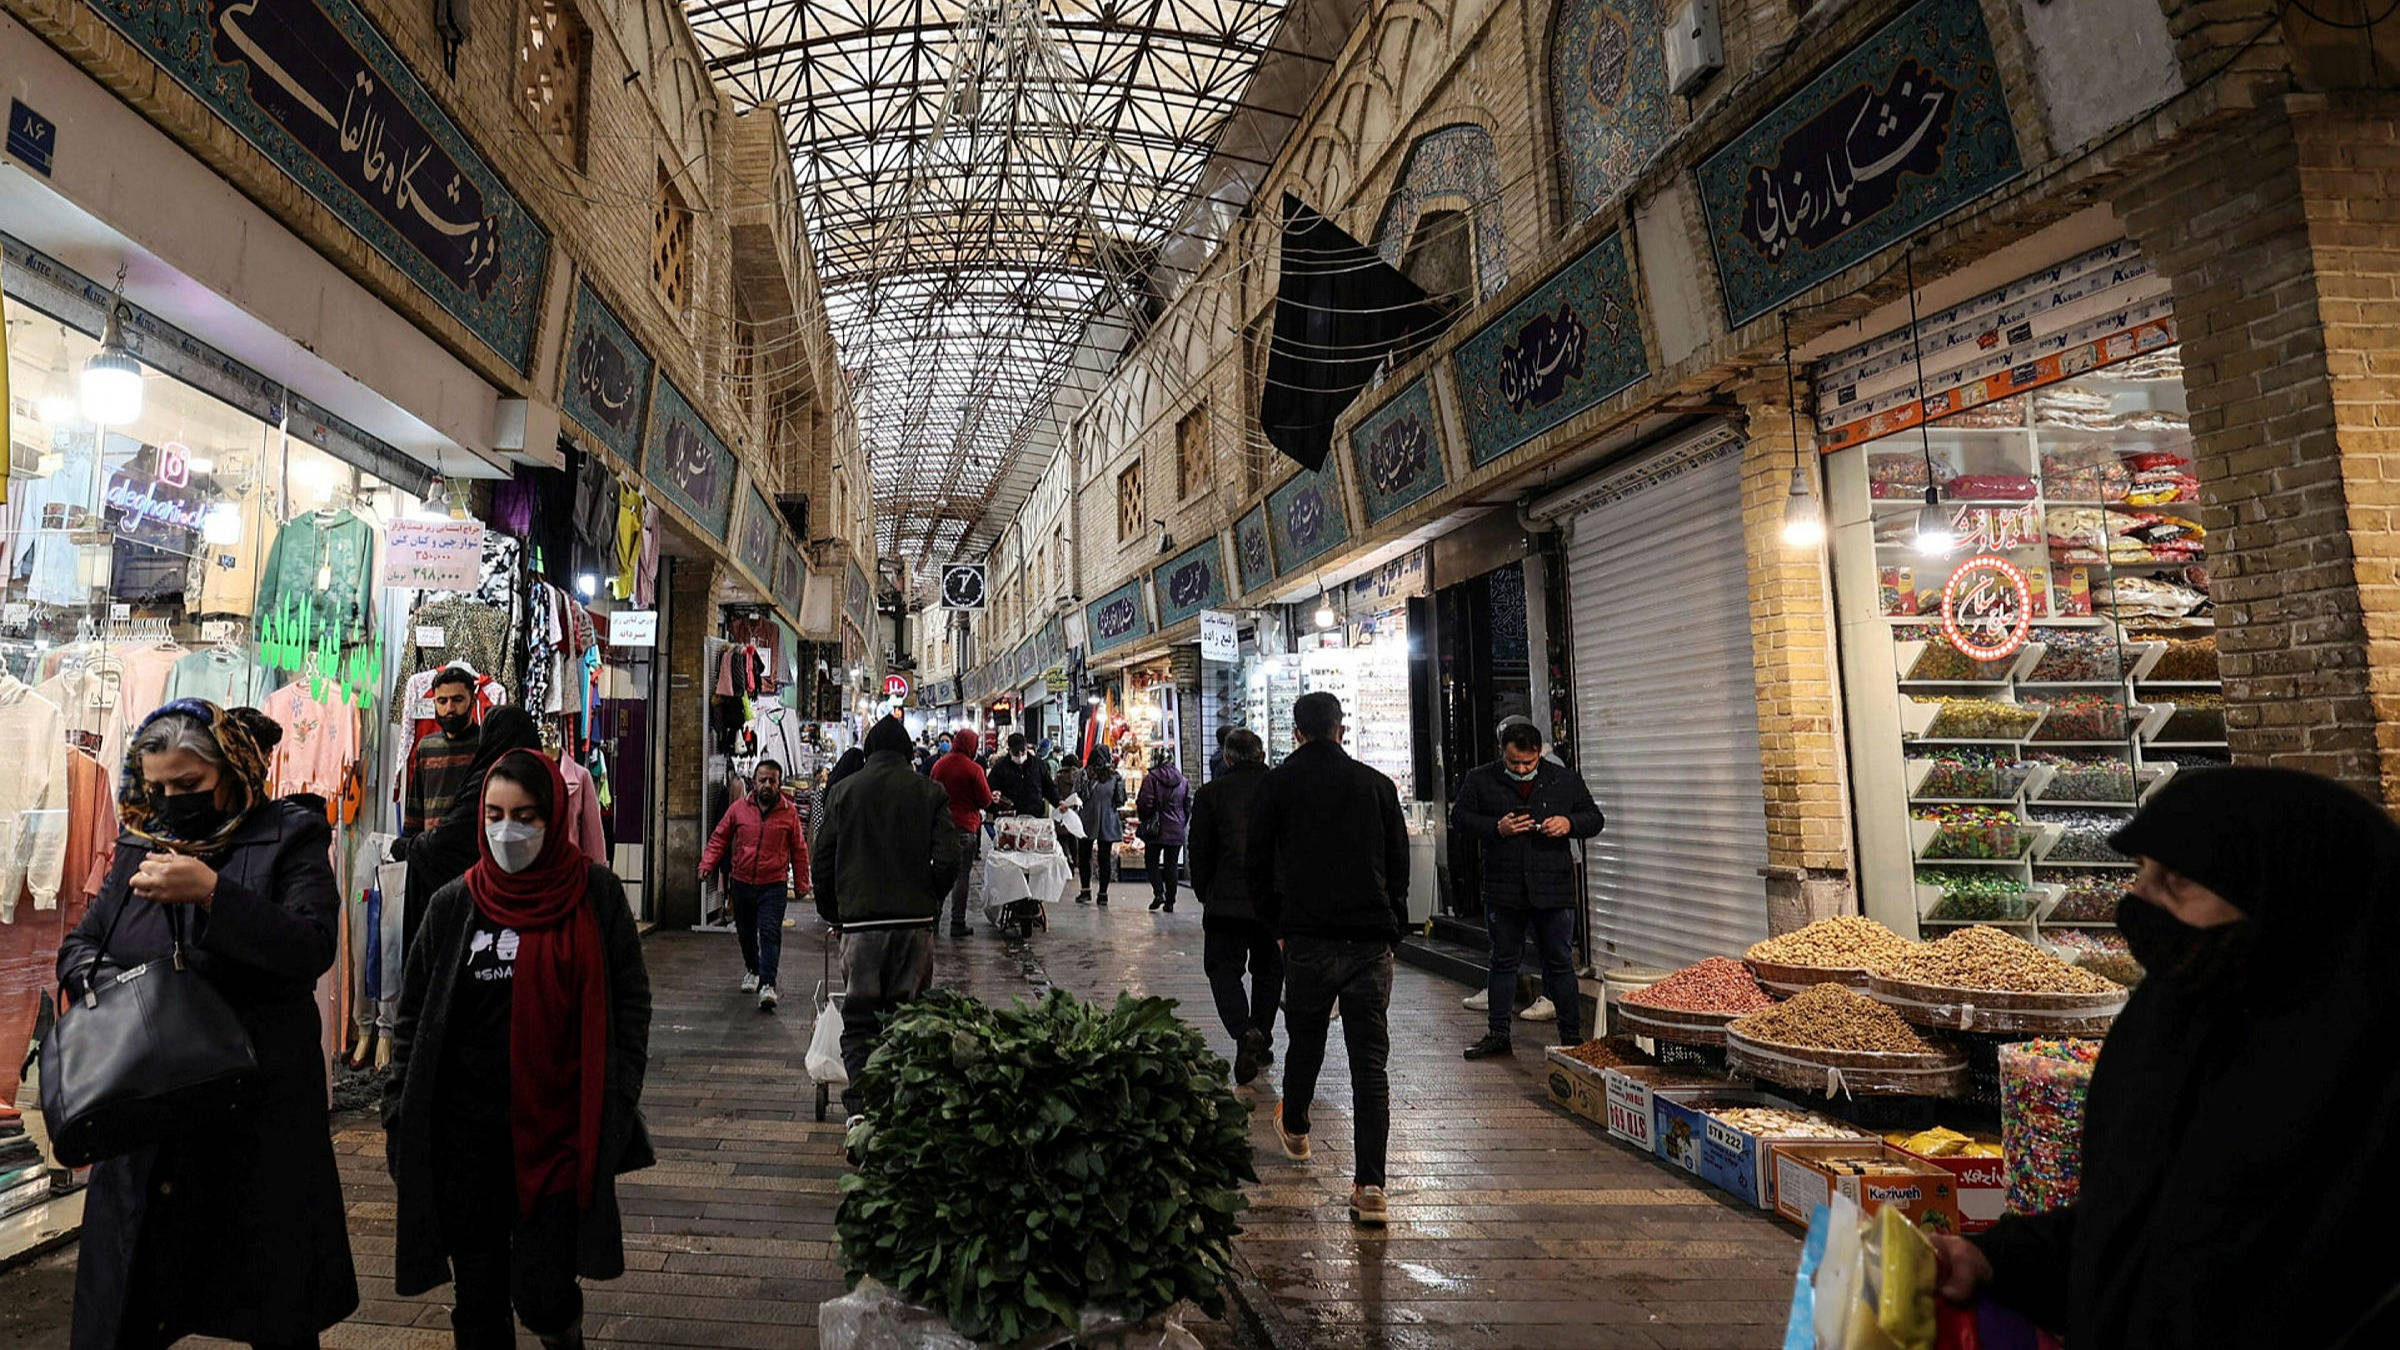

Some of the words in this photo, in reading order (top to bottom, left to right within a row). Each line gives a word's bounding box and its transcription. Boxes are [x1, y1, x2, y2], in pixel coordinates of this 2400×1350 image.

[220, 0, 385, 181] طالقای
[24, 116, 46, 140] ۸۶
[1821, 82, 1945, 225] خشکبار
[383, 145, 493, 278] فروشگاه
[1756, 170, 1819, 256] رضایی
[1502, 348, 1529, 402] تورانی
[1529, 315, 1580, 391] فروشگاه
[1988, 501, 2033, 551] آجیل
[1726, 1134, 1741, 1150] 222
[1868, 1185, 1921, 1200] Kaziweh
